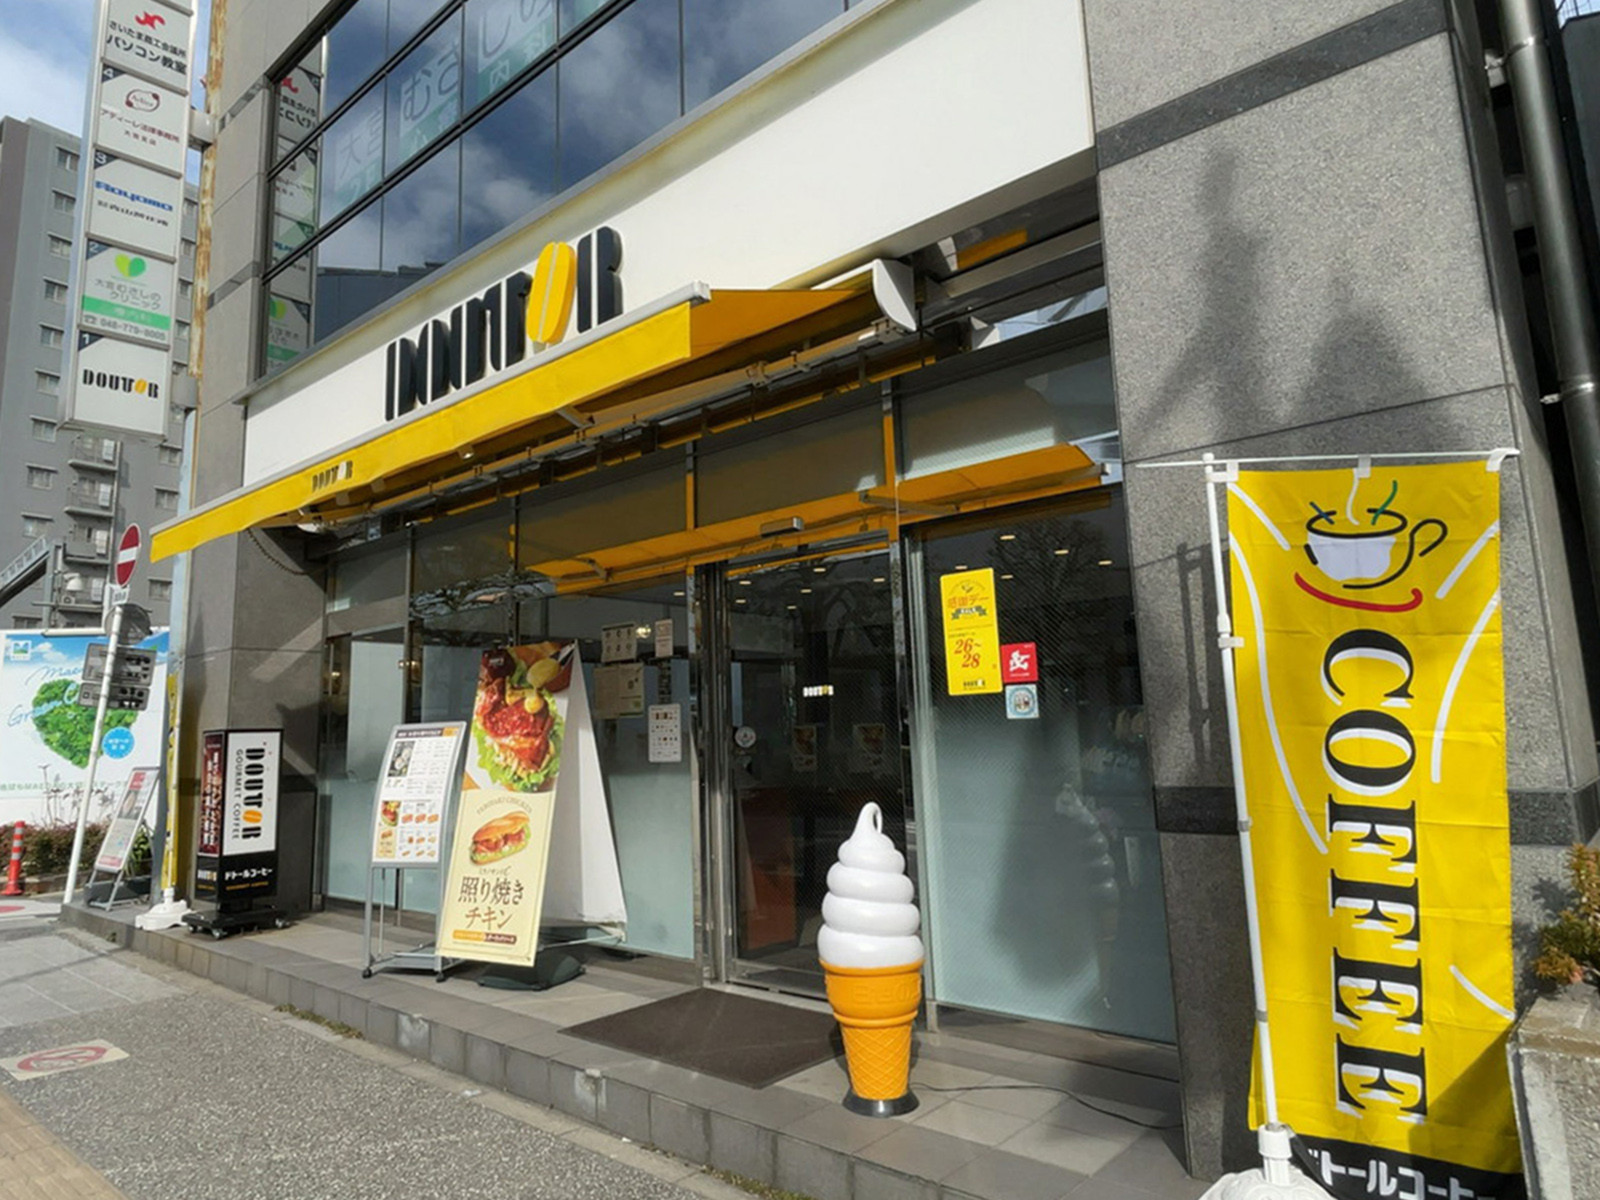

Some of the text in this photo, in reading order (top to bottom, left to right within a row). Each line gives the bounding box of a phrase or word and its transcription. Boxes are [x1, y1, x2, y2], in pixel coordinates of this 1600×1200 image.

[106, 35, 187, 75] パソコン教室
[103, 68, 114, 78] 4
[96, 153, 107, 164] 3
[89, 241, 100, 252] 2
[385, 226, 624, 422] DOUTOR
[82, 334, 90, 345] 1
[82, 368, 159, 399] DOUTOR
[961, 653, 981, 668] 28
[231, 748, 244, 840] GOURMET COFFEE
[241, 748, 266, 839] DOUTOR
[224, 867, 273, 881] ドトールコーヒー
[1320, 628, 1428, 1126] COFFEE
[458, 875, 524, 905] 照り焼き
[465, 906, 513, 931] チキン
